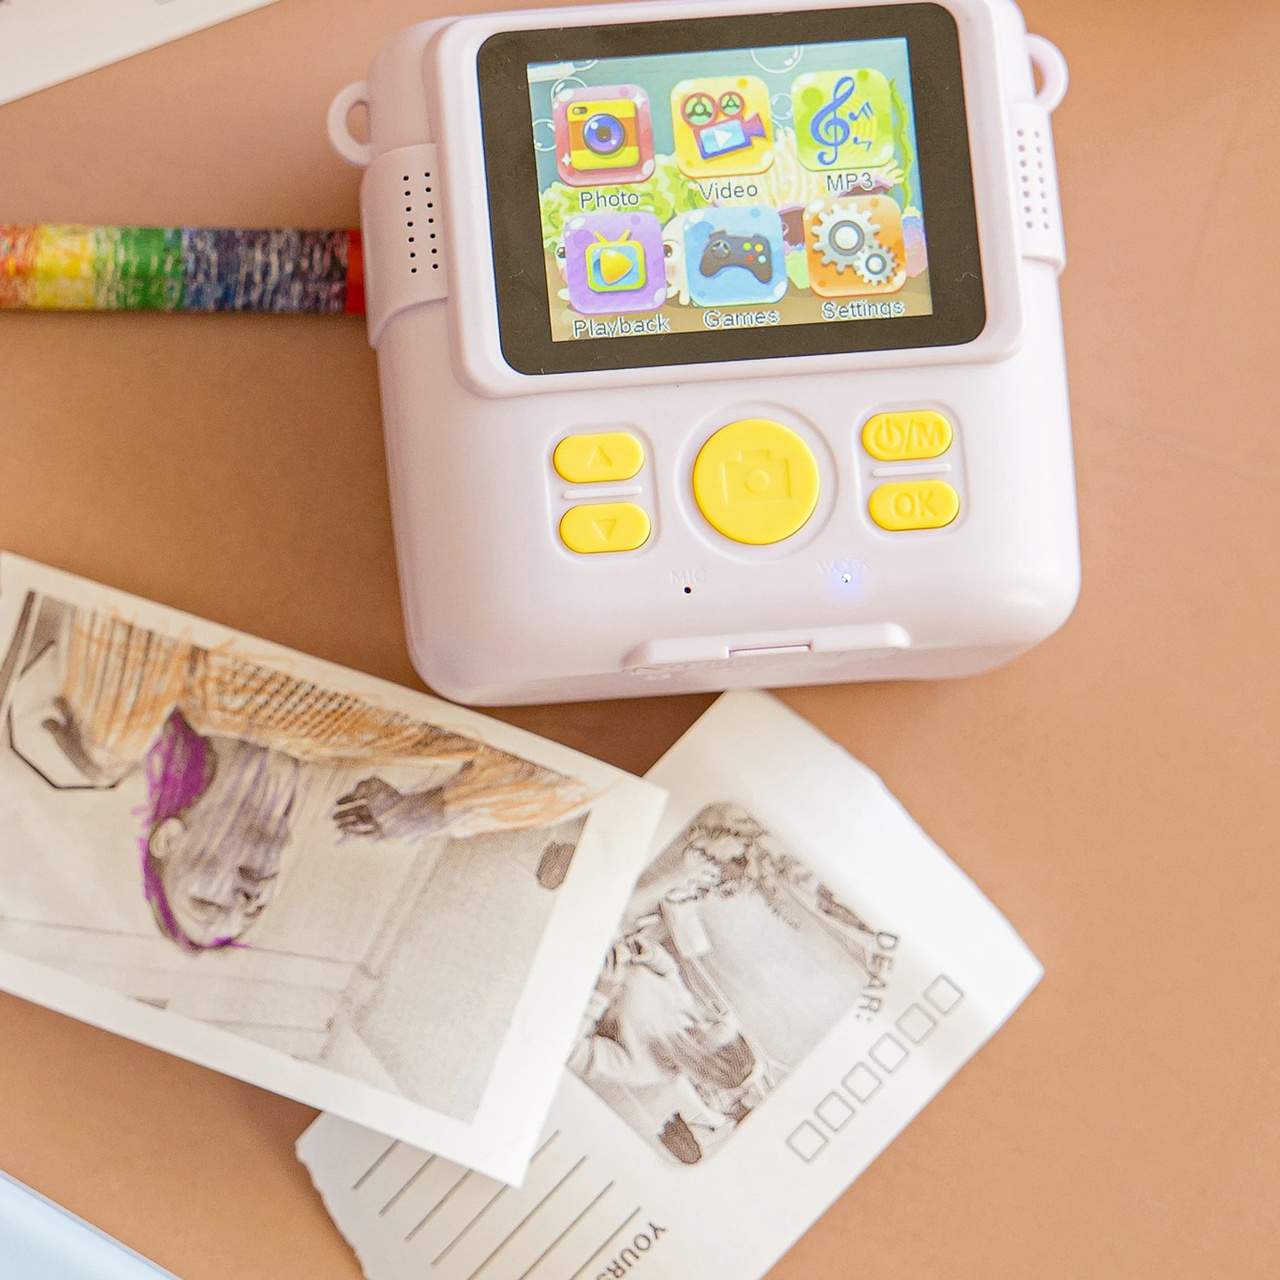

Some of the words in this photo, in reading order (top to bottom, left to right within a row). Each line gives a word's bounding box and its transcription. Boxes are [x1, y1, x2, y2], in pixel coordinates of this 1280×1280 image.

[698, 182, 758, 201] Video
[826, 172, 874, 192] MP3
[579, 190, 640, 209] Photo
[703, 309, 780, 329] Games
[821, 299, 906, 321] Settings
[573, 314, 670, 339] Playback
[890, 489, 938, 519] OK
[816, 557, 872, 574] WORK
[670, 567, 707, 585] MIC
